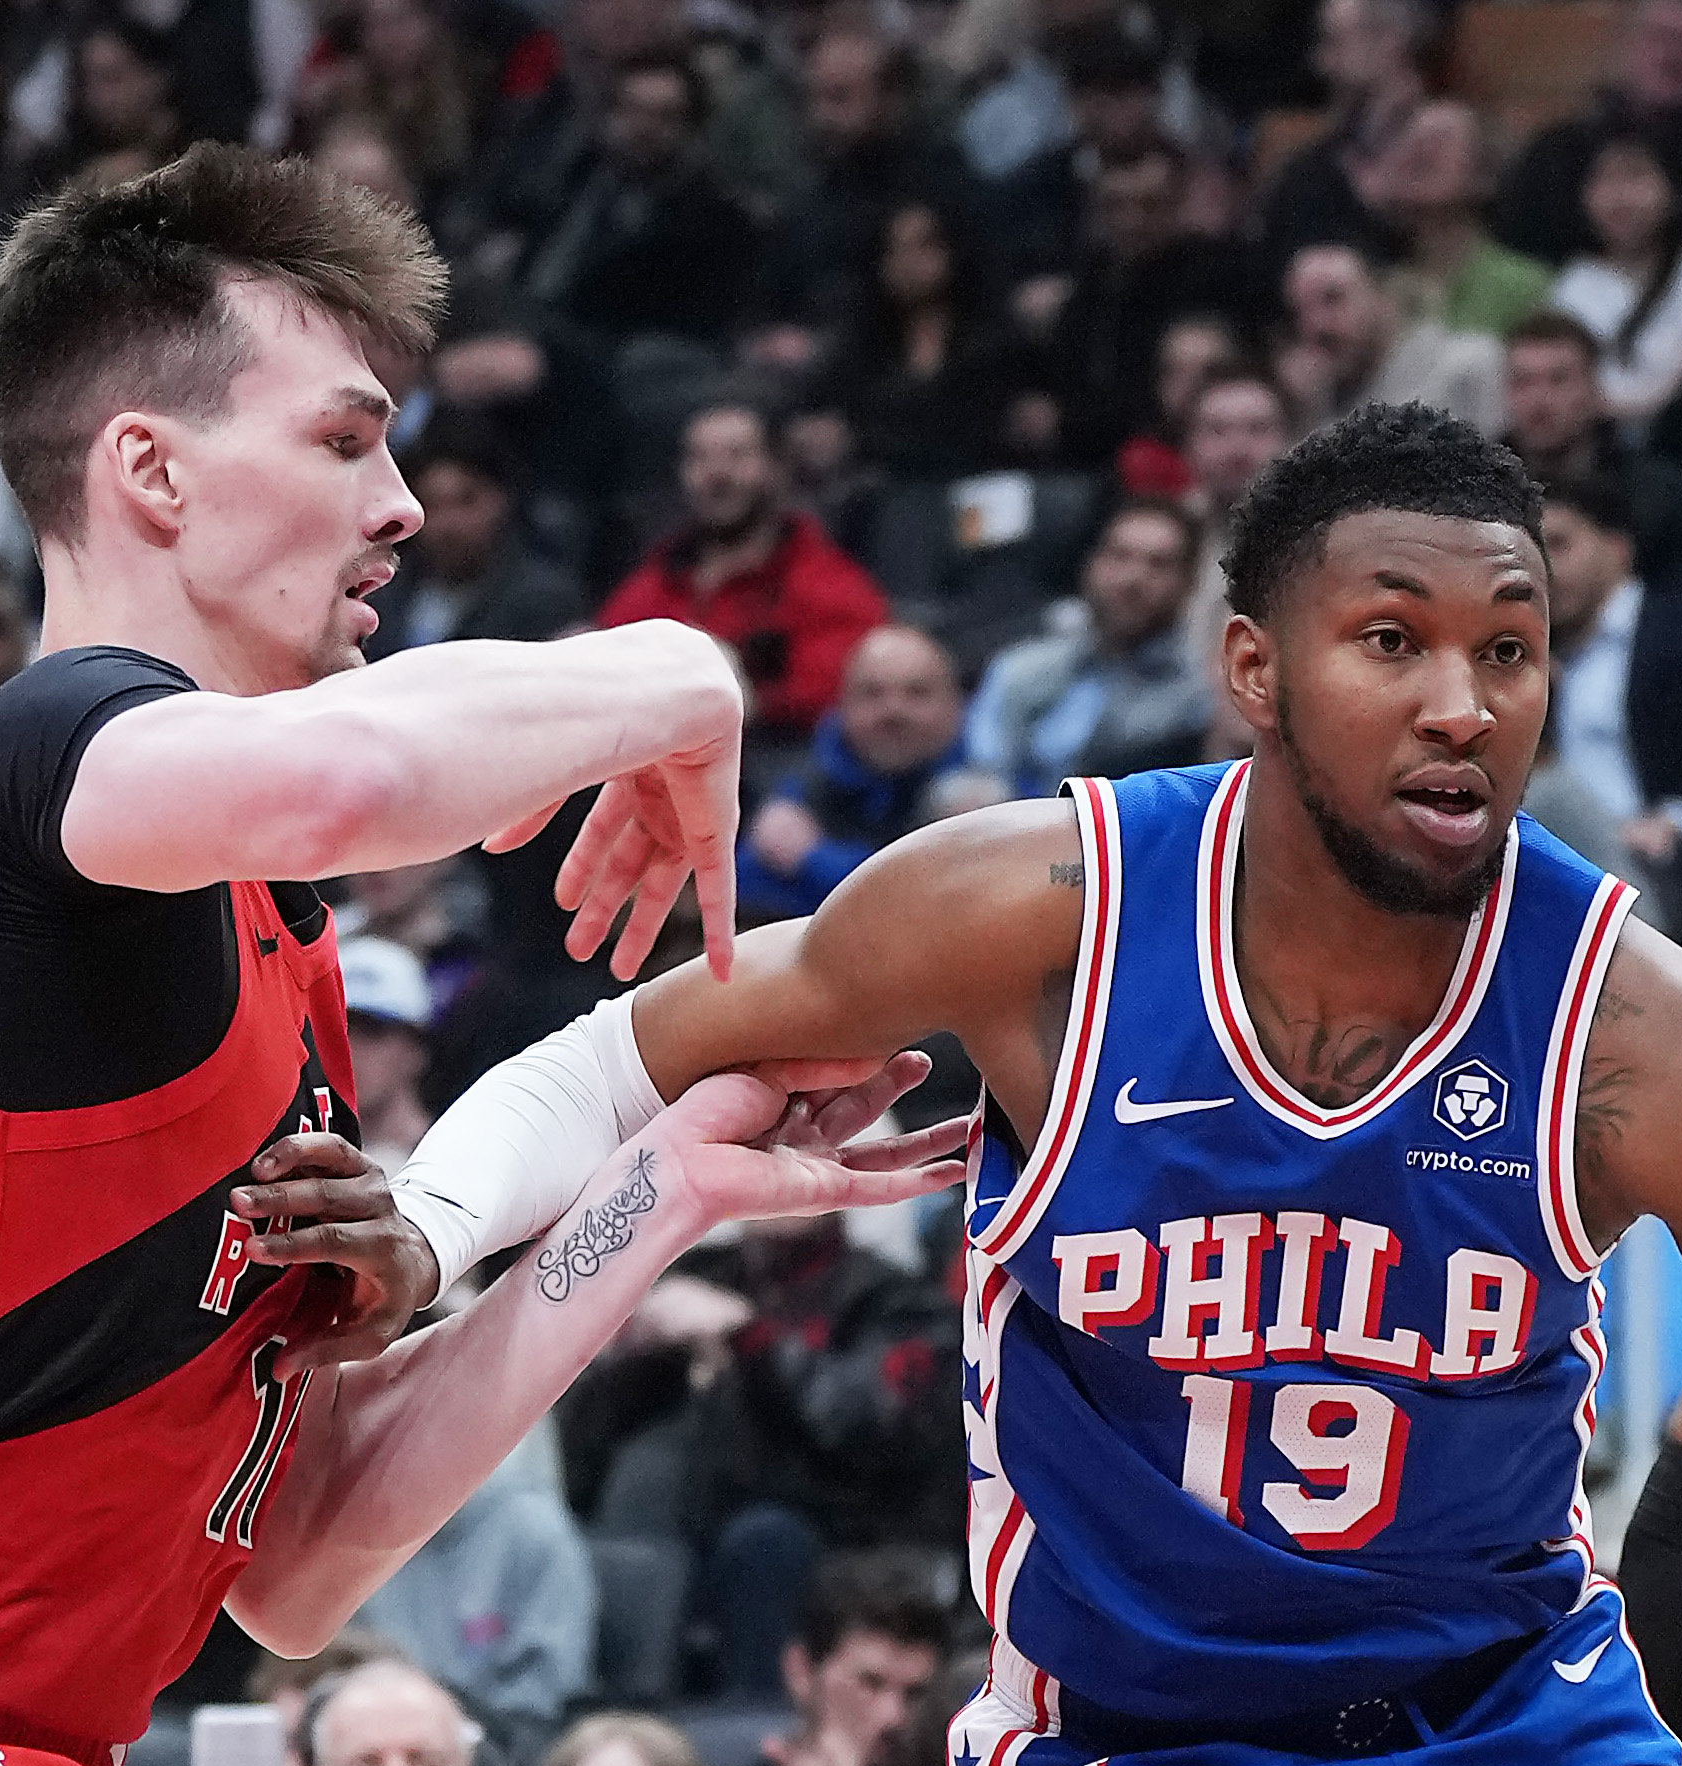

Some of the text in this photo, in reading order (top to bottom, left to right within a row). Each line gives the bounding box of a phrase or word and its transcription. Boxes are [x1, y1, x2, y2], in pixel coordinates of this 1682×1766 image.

[1406, 1150, 1531, 1179] crypto.com
[1052, 1210, 1540, 1382] PHILA
[1180, 1374, 1412, 1551] 19
